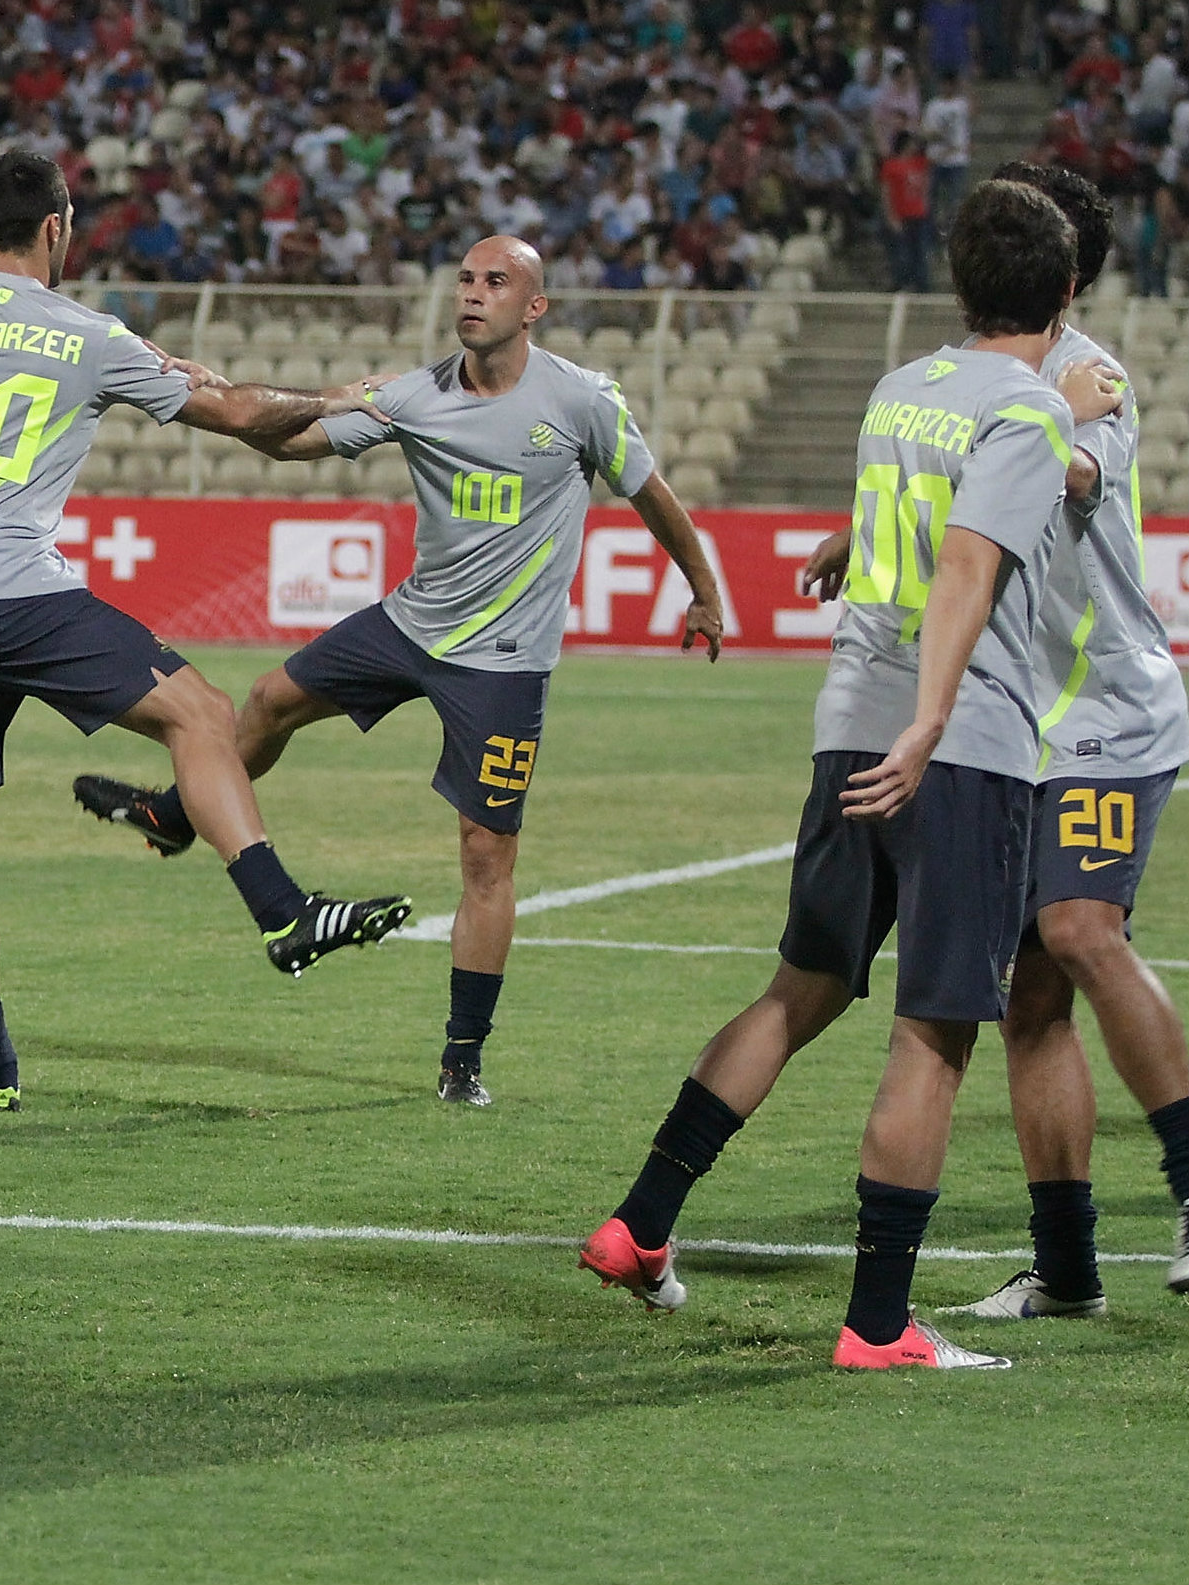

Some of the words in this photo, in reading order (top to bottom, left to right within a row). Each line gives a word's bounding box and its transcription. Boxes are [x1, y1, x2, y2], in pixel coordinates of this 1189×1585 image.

[520, 450, 563, 458] AUSTRALIA
[451, 470, 522, 525] 100
[478, 735, 536, 790] 23
[1059, 788, 1134, 854] 20
